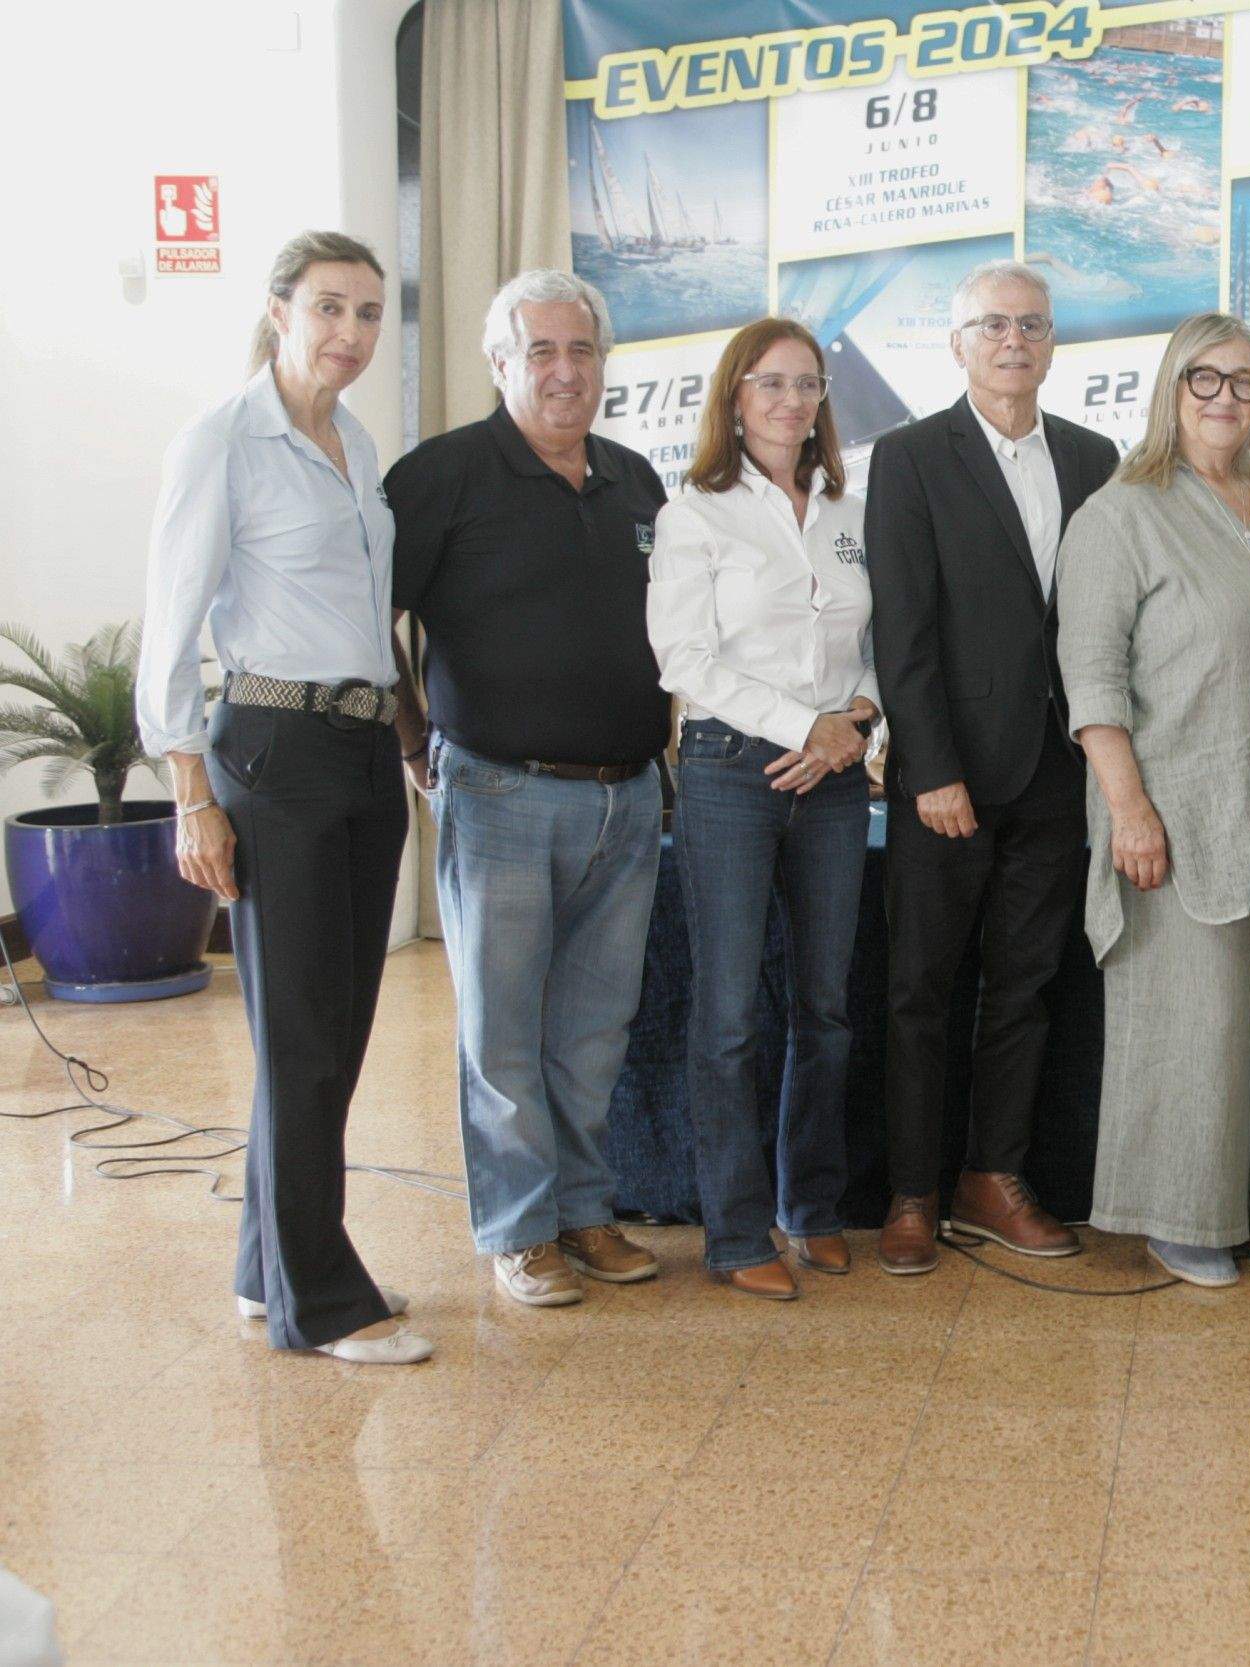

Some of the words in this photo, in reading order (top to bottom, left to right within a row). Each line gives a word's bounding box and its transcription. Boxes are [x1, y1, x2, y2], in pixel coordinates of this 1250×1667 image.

[604, 30, 886, 108] EVENTOS
[916, 6, 1093, 68] 2024
[865, 88, 938, 130] 6/8
[865, 134, 938, 154] JUNIO
[848, 173, 873, 188] XIII
[879, 163, 940, 183] TROFEO
[826, 192, 876, 212] CÉSAR
[882, 180, 968, 203] MANRIQUE
[922, 196, 991, 218] MARINAS
[604, 373, 703, 419] 27/2
[1084, 370, 1140, 407] 22
